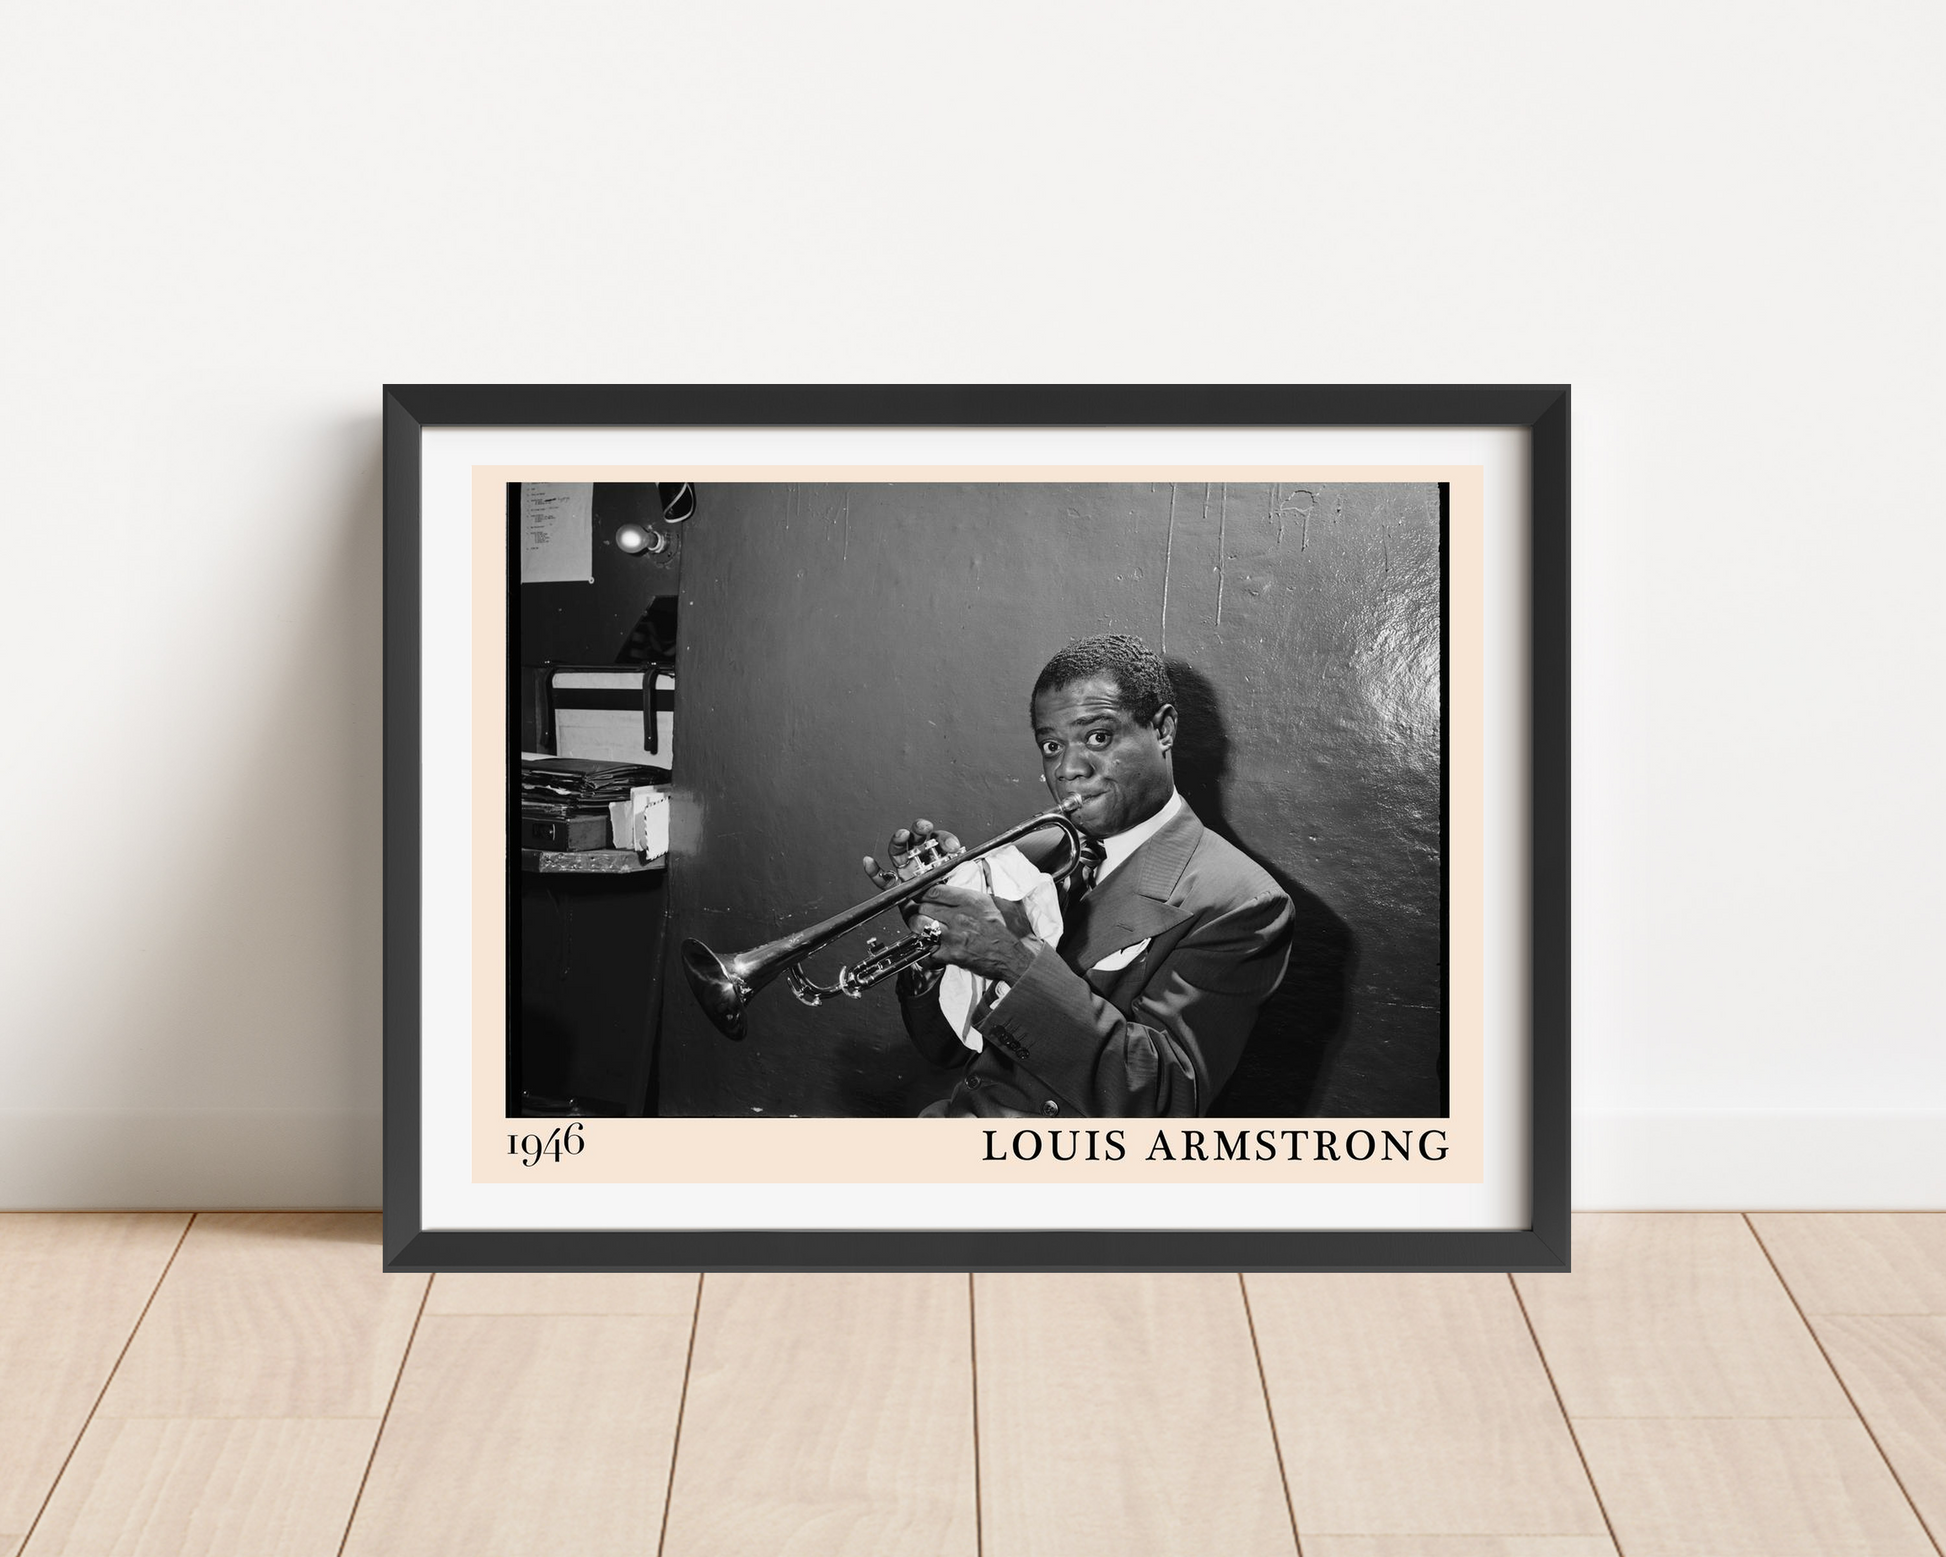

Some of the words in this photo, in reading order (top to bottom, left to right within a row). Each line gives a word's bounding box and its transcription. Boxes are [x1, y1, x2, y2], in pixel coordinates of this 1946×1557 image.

[507, 1121, 585, 1167] 1946
[982, 1129, 1126, 1161] LOUIS
[1145, 1129, 1449, 1161] ARMSTRONG
